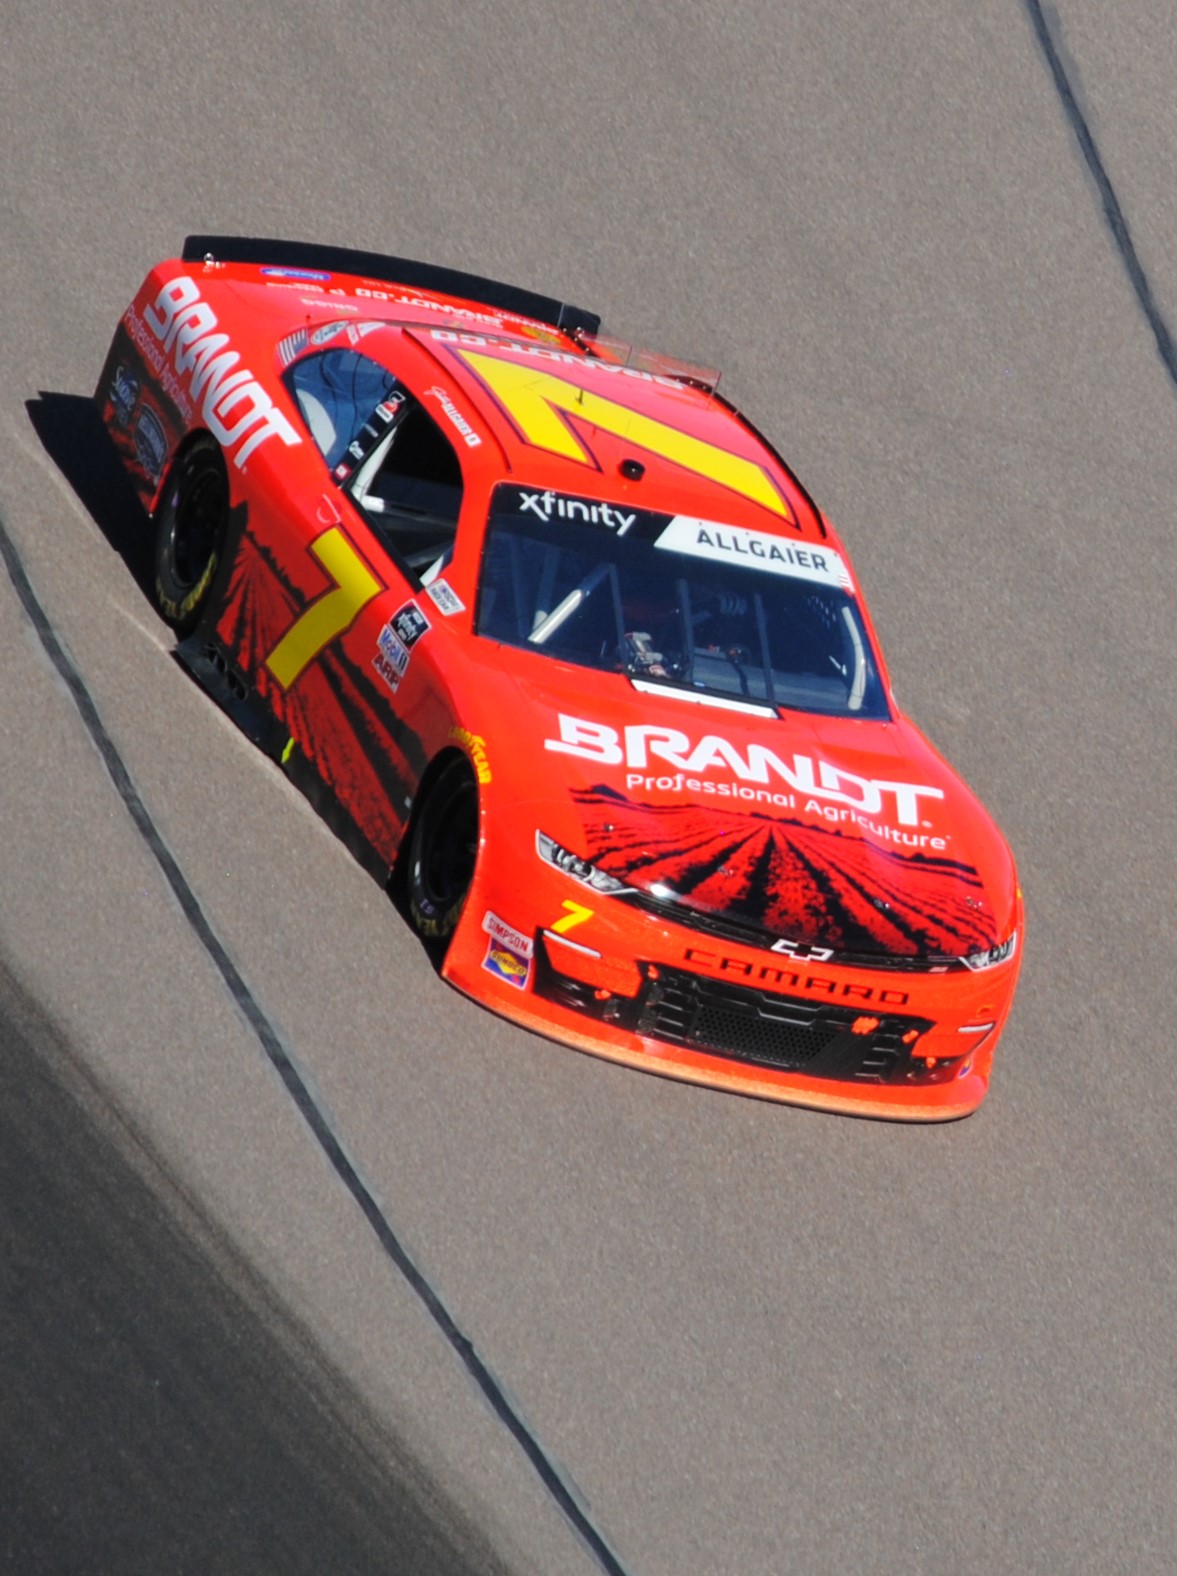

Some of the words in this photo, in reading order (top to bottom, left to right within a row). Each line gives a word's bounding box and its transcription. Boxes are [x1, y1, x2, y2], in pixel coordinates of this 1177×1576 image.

[124, 304, 165, 374] Professional
[143, 276, 303, 469] BRANDT
[447, 344, 797, 526] 7
[519, 491, 637, 536] xfinity
[696, 528, 830, 573] ALLGAIER
[264, 525, 384, 691] 7
[373, 652, 399, 685] ARP
[543, 712, 945, 827] BRANDT
[626, 772, 796, 809] Professional
[804, 799, 948, 850] Agriculture
[488, 917, 529, 953] SIMPSON
[550, 899, 595, 934] 7
[491, 951, 528, 976] SUNOCO
[684, 947, 909, 1006] CAMARO
